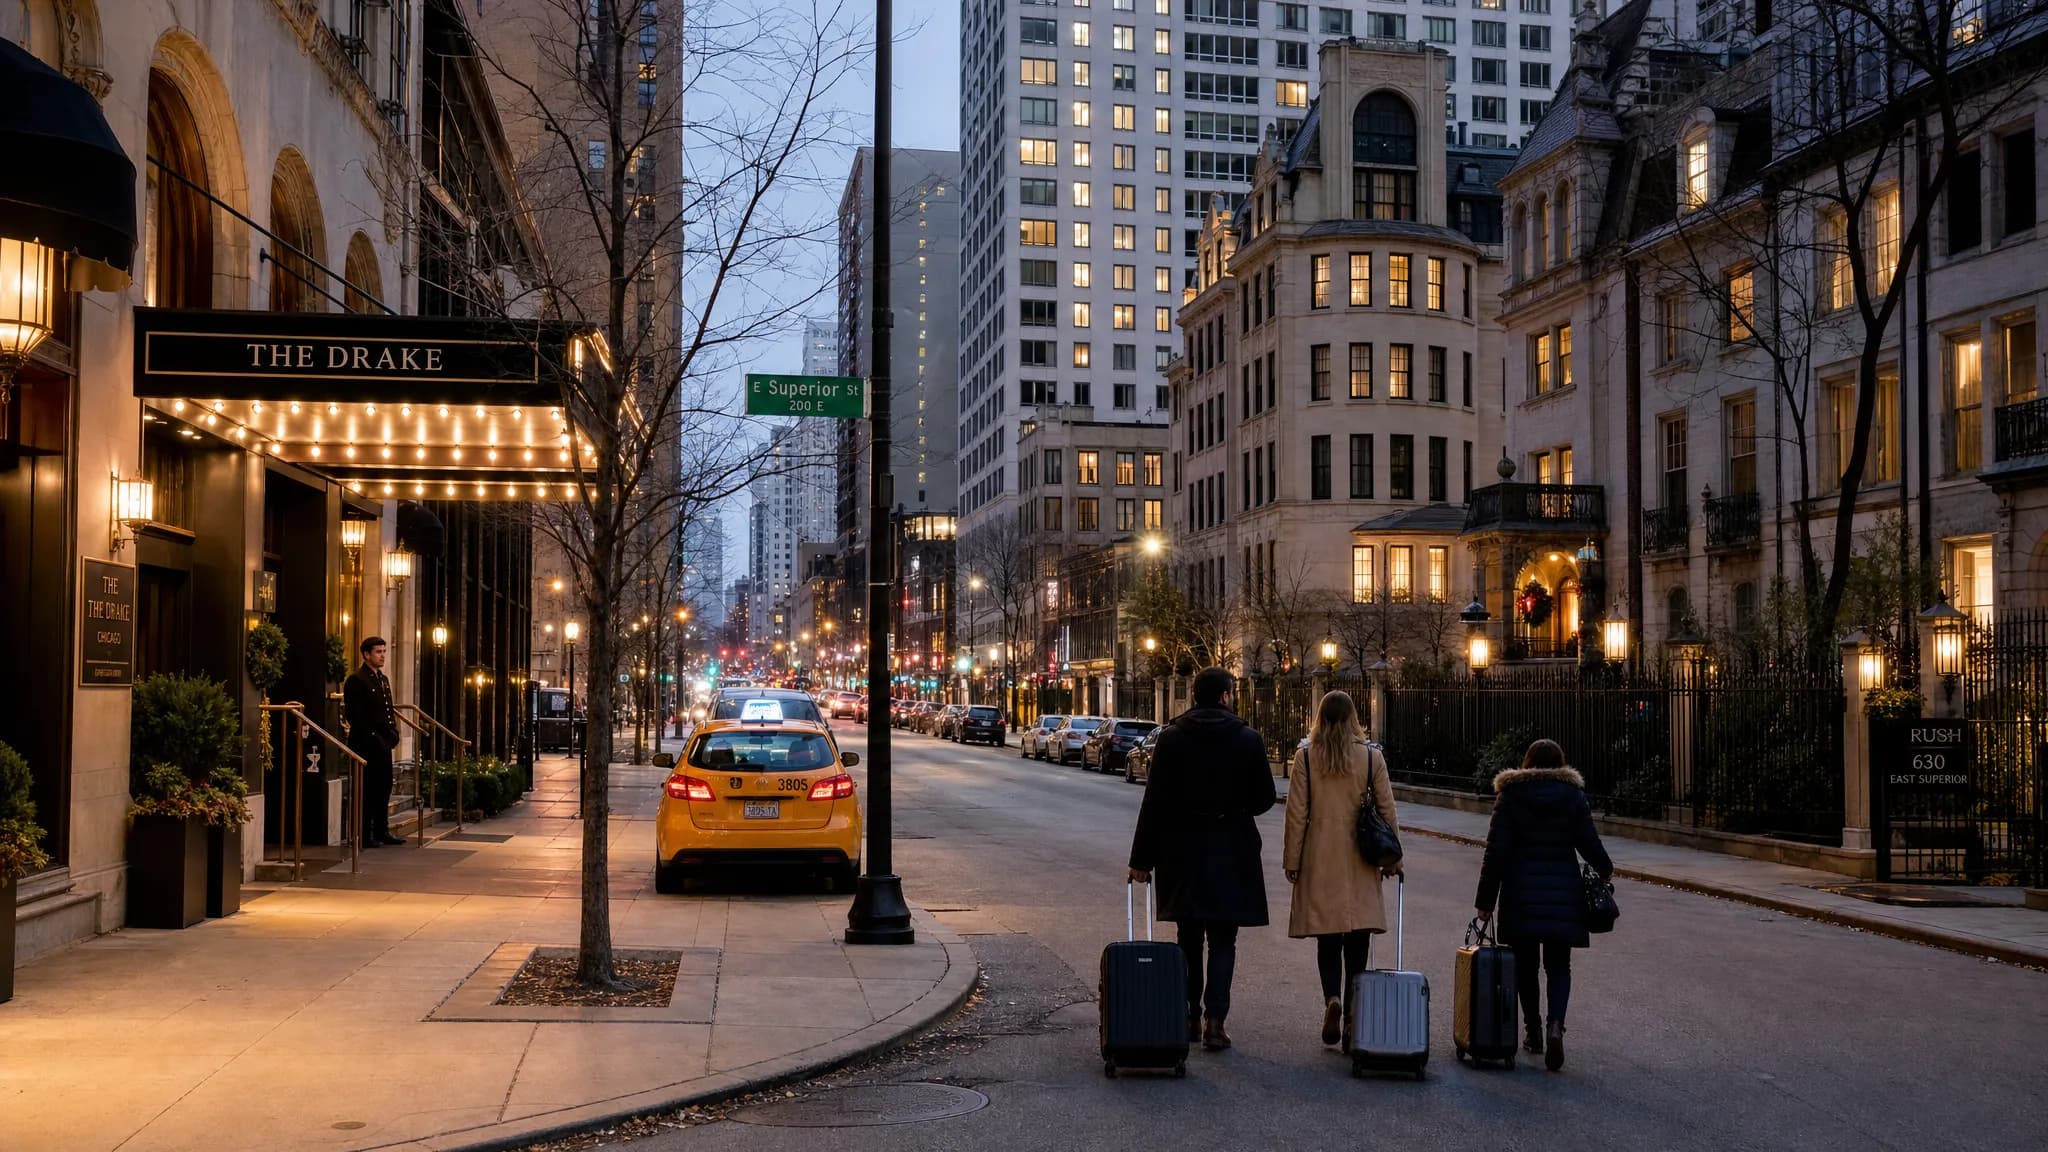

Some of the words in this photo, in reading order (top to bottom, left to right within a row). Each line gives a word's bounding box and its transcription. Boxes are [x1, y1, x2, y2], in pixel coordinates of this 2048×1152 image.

[246, 343, 314, 368] THE
[327, 346, 443, 371] DRAKE
[753, 381, 761, 393] E
[768, 380, 840, 399] Superior
[846, 385, 859, 396] St
[789, 400, 811, 411] 200
[817, 401, 825, 412] E
[102, 576, 119, 595] THE
[88, 599, 104, 619] THE
[1911, 728, 1962, 743] RUSH
[1912, 754, 1945, 770] 630
[777, 778, 808, 791] 3805
[1890, 774, 1915, 784] EAST
[1918, 774, 1968, 784] SUPERIOR
